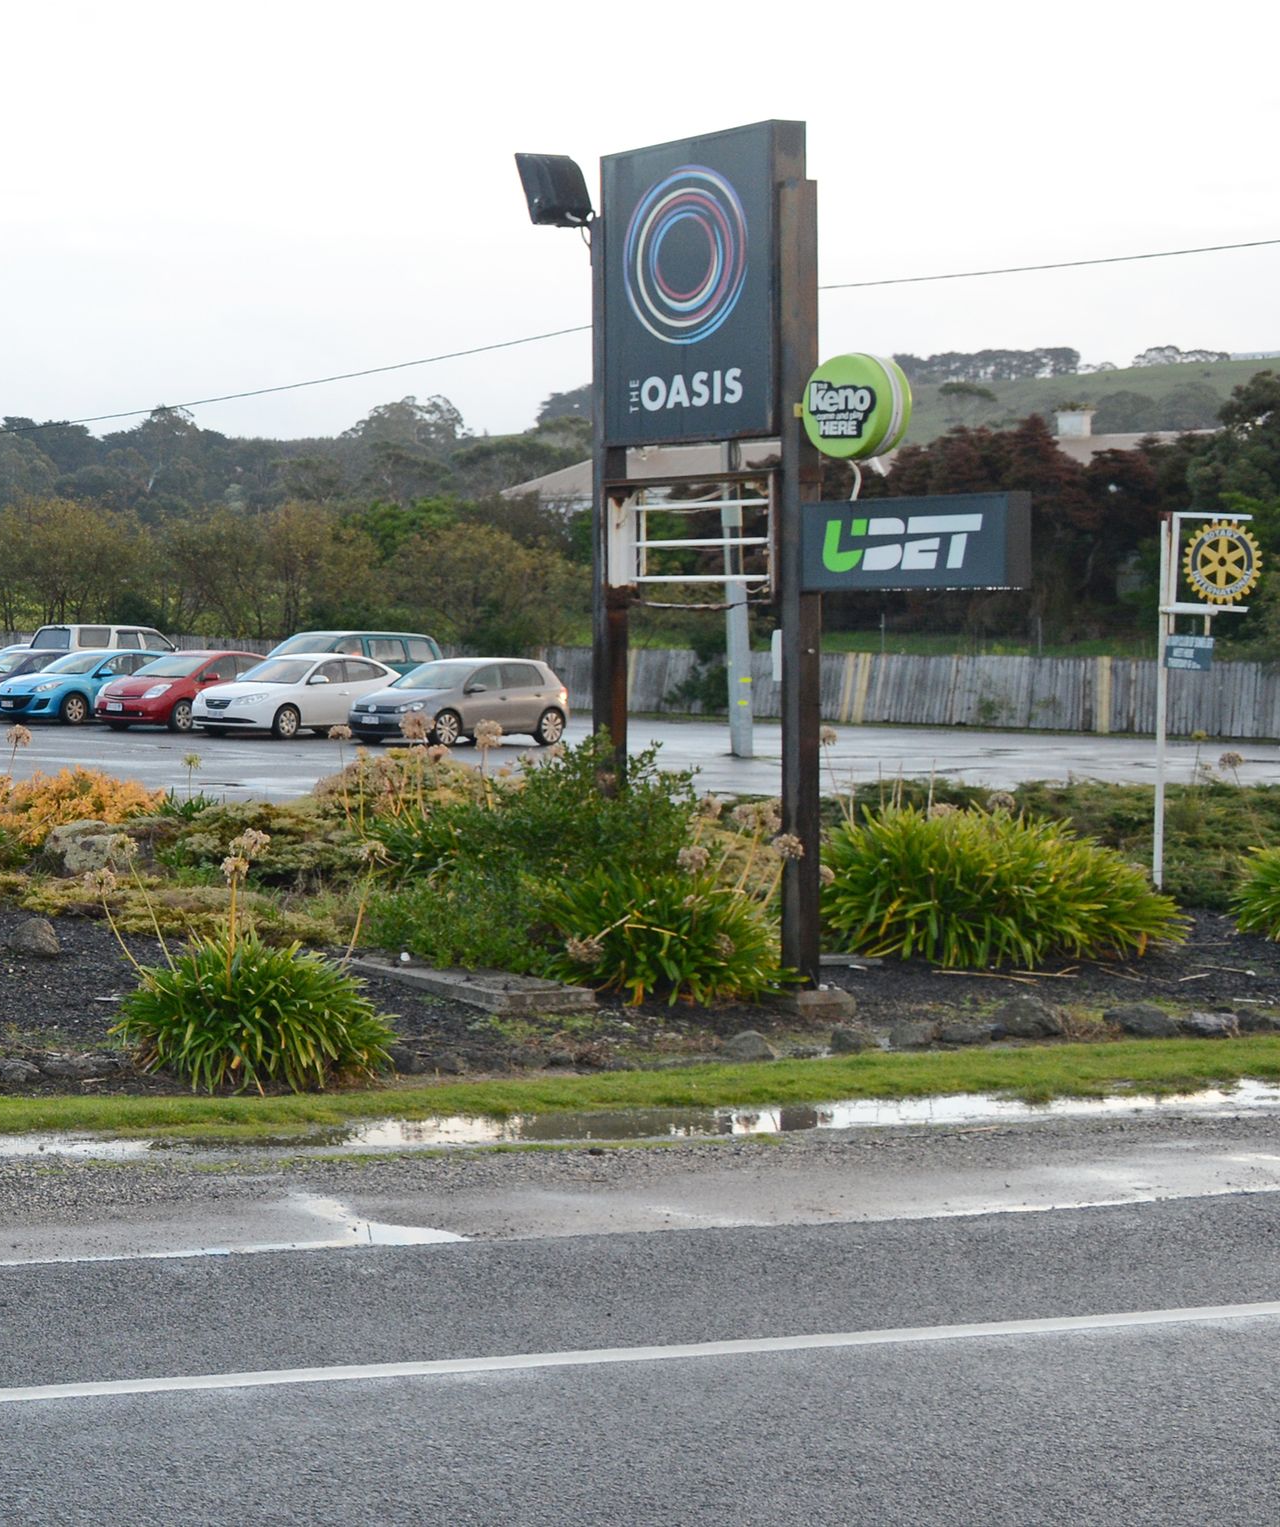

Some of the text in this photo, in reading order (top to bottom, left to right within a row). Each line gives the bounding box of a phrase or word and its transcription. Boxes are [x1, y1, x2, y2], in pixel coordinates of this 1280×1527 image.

[629, 367, 743, 414] THE OASIS
[810, 383, 871, 412] keno
[820, 421, 857, 435] HERE
[822, 513, 983, 573] UBET
[1192, 568, 1253, 596] INTERNATIONAL
